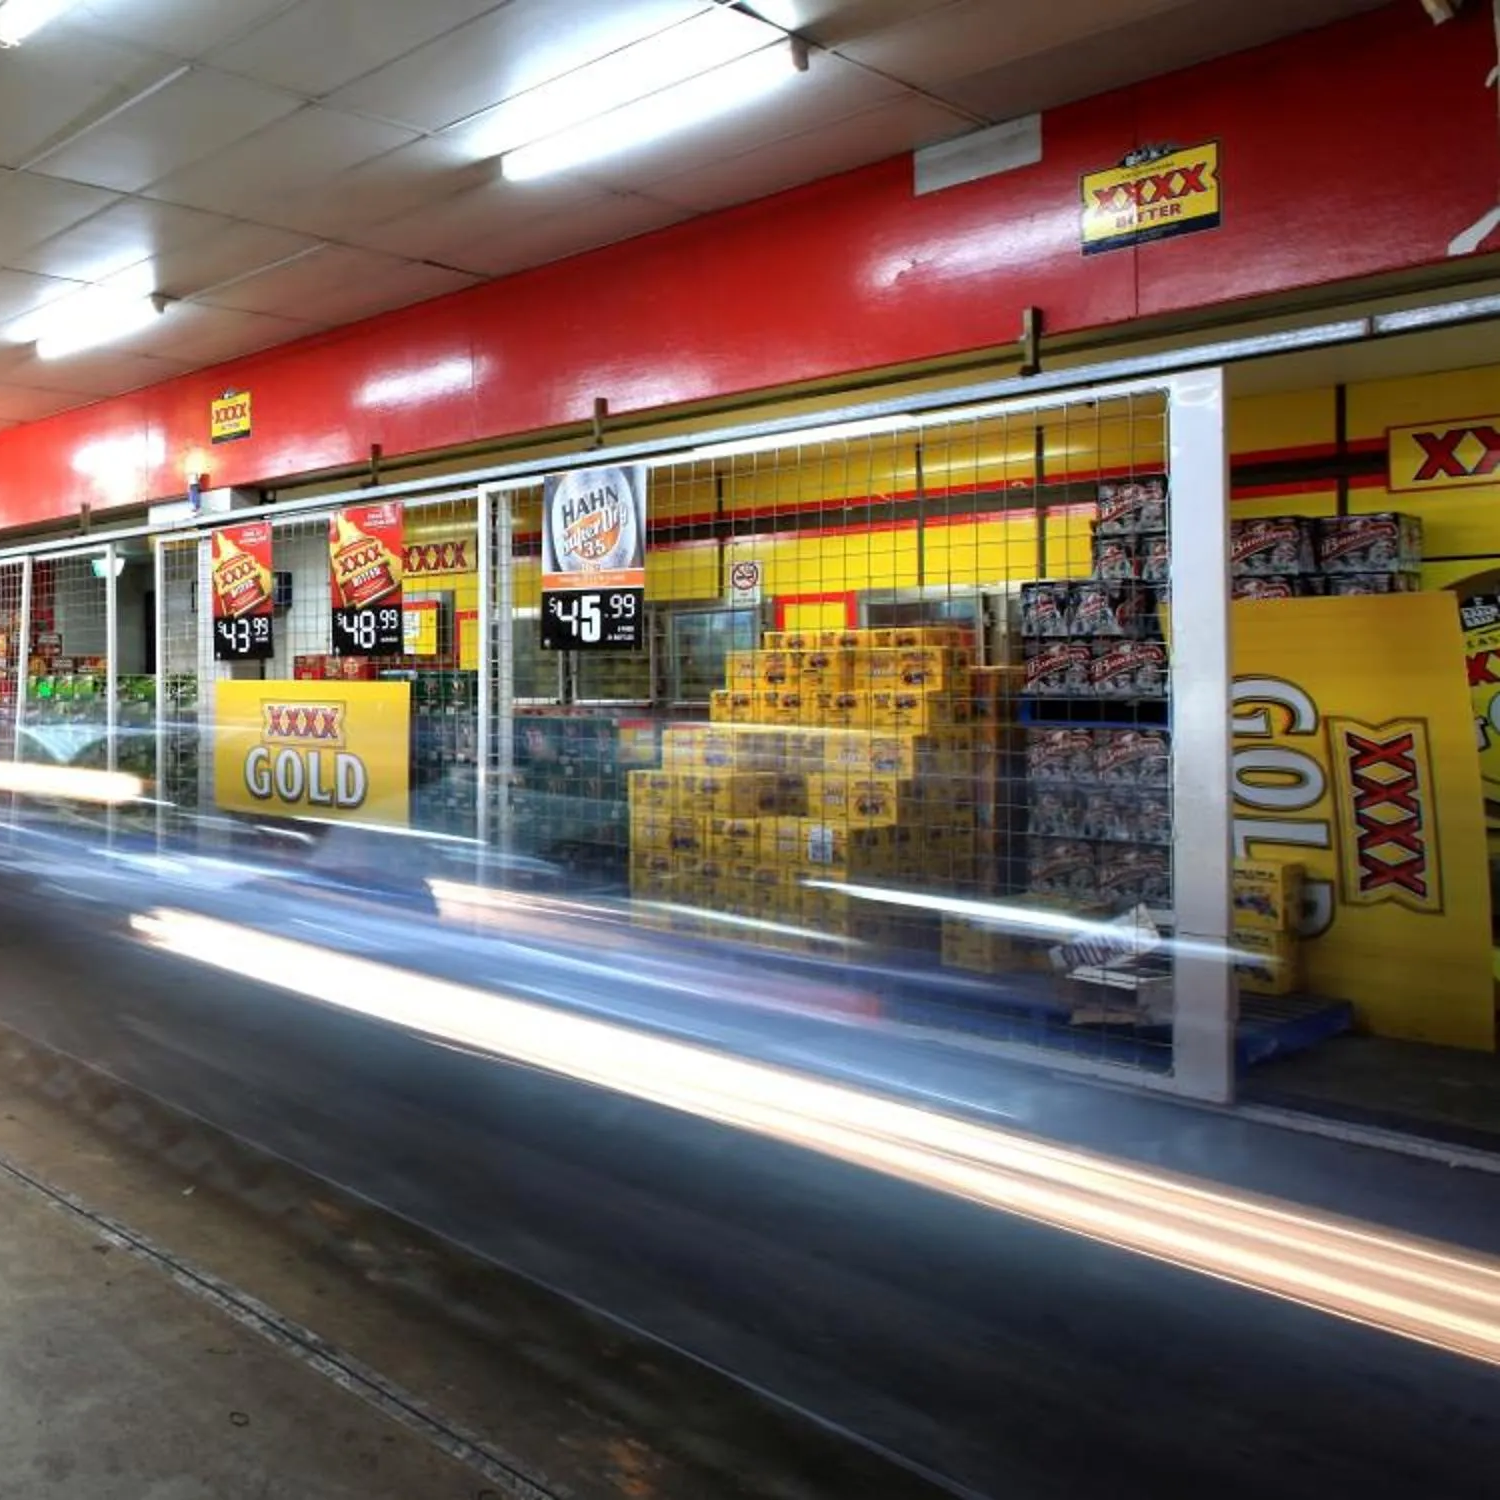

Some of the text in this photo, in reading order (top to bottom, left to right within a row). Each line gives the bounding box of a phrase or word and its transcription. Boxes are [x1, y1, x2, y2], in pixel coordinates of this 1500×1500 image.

[1092, 162, 1207, 213] XXXX
[1116, 203, 1182, 229] BITTER
[212, 401, 247, 424] XXXX
[562, 485, 619, 527] HAHN
[339, 543, 381, 577] XXXX
[402, 539, 467, 573] XXXX
[216, 557, 256, 591] XXXX
[267, 706, 338, 738] XXXX
[244, 745, 368, 808] GOLD
[1233, 674, 1336, 940] GOL
[1346, 731, 1427, 898] XXXX
